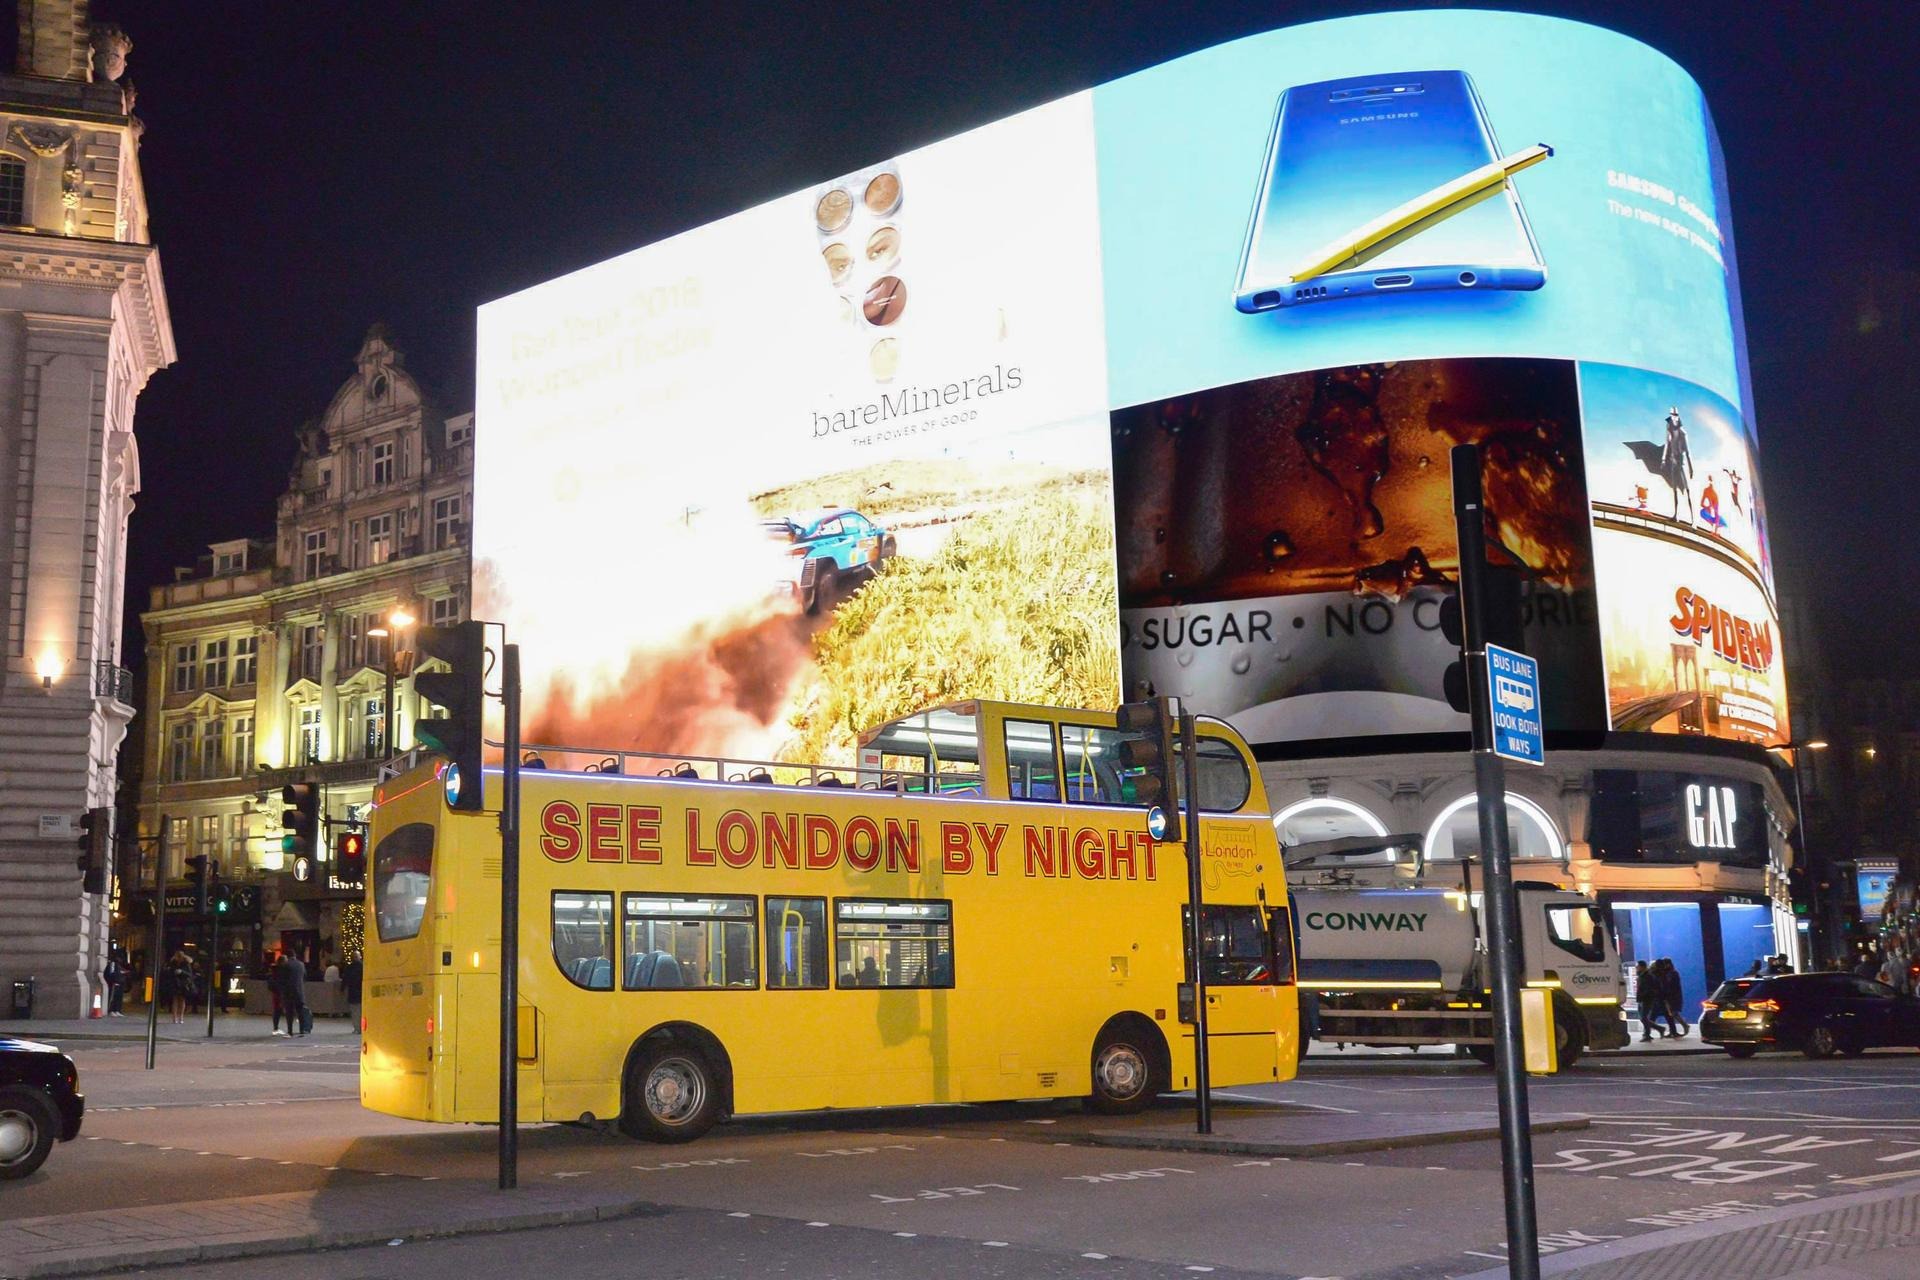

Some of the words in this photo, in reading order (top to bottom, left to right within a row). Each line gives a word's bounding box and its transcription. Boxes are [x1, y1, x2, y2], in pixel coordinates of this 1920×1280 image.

[1340, 112, 1419, 125] SAMSUNG
[812, 365, 1022, 437] bareMinerals
[852, 437, 872, 446] THE
[877, 425, 917, 441] POWER
[921, 421, 936, 432] OF
[941, 410, 978, 427] GOOD
[1141, 609, 1272, 650] SUGAR
[1325, 598, 1394, 638] NO
[1493, 653, 1511, 672] BUS
[1512, 661, 1532, 679] LANE
[1495, 711, 1517, 730] LOOK
[1518, 718, 1539, 736] BOTH
[1508, 736, 1530, 755] WAYS
[1686, 784, 1736, 848] GAP
[540, 800, 662, 864] SEE
[686, 808, 920, 873] LONDON
[940, 820, 1008, 876] BY
[1023, 824, 1162, 881] NIGHT
[1206, 841, 1253, 859] London
[1306, 911, 1428, 932] CONWAY
[1572, 973, 1611, 985] CONWAY
[632, 1158, 750, 1171] LOOK
[795, 1145, 916, 1157] LEFT
[1502, 1147, 1818, 1184] BUS
[1063, 1167, 1195, 1183] LOOK
[869, 1183, 1021, 1204] LEFT
[1626, 1200, 1775, 1227] RIGHT
